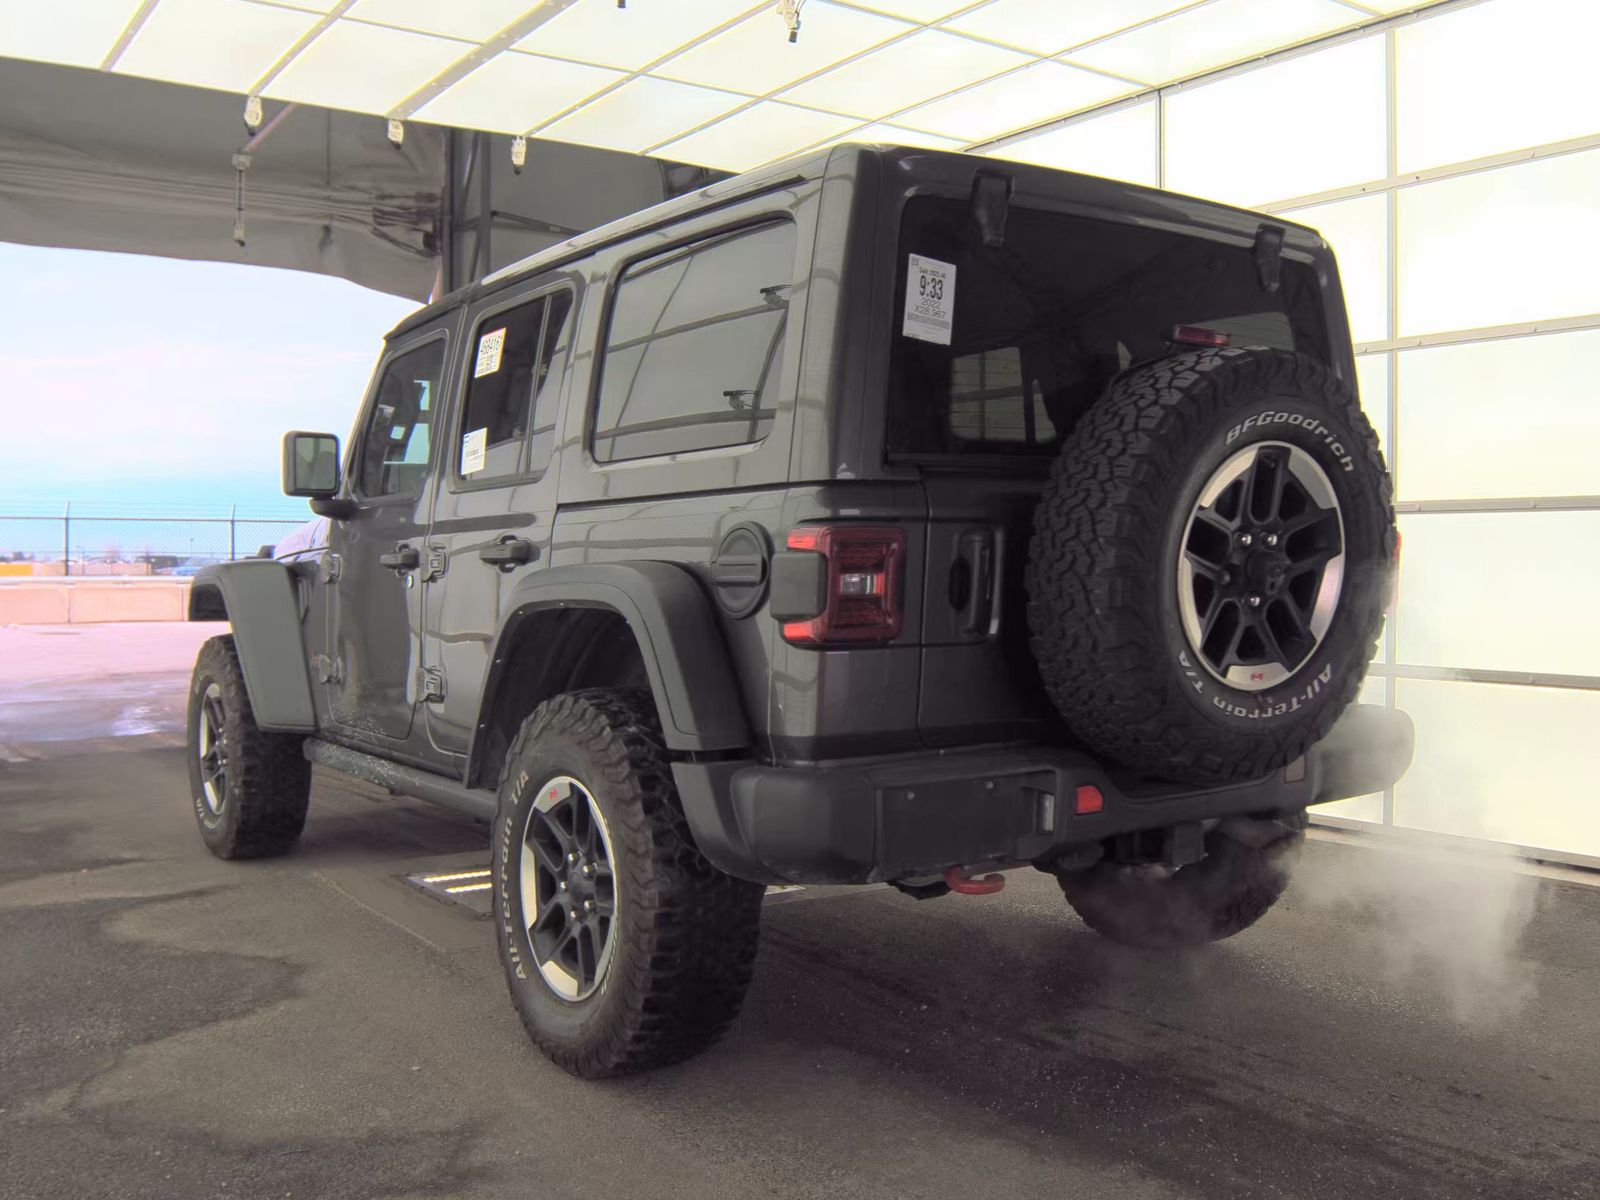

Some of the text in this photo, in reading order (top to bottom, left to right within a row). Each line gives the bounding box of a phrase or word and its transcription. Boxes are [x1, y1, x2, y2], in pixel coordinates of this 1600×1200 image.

[920, 274, 943, 300] 9:33
[1226, 411, 1354, 471] BFGoodrich
[1178, 650, 1332, 719] All-Terrain T/A
[500, 770, 529, 979] All-Terrain T/A
